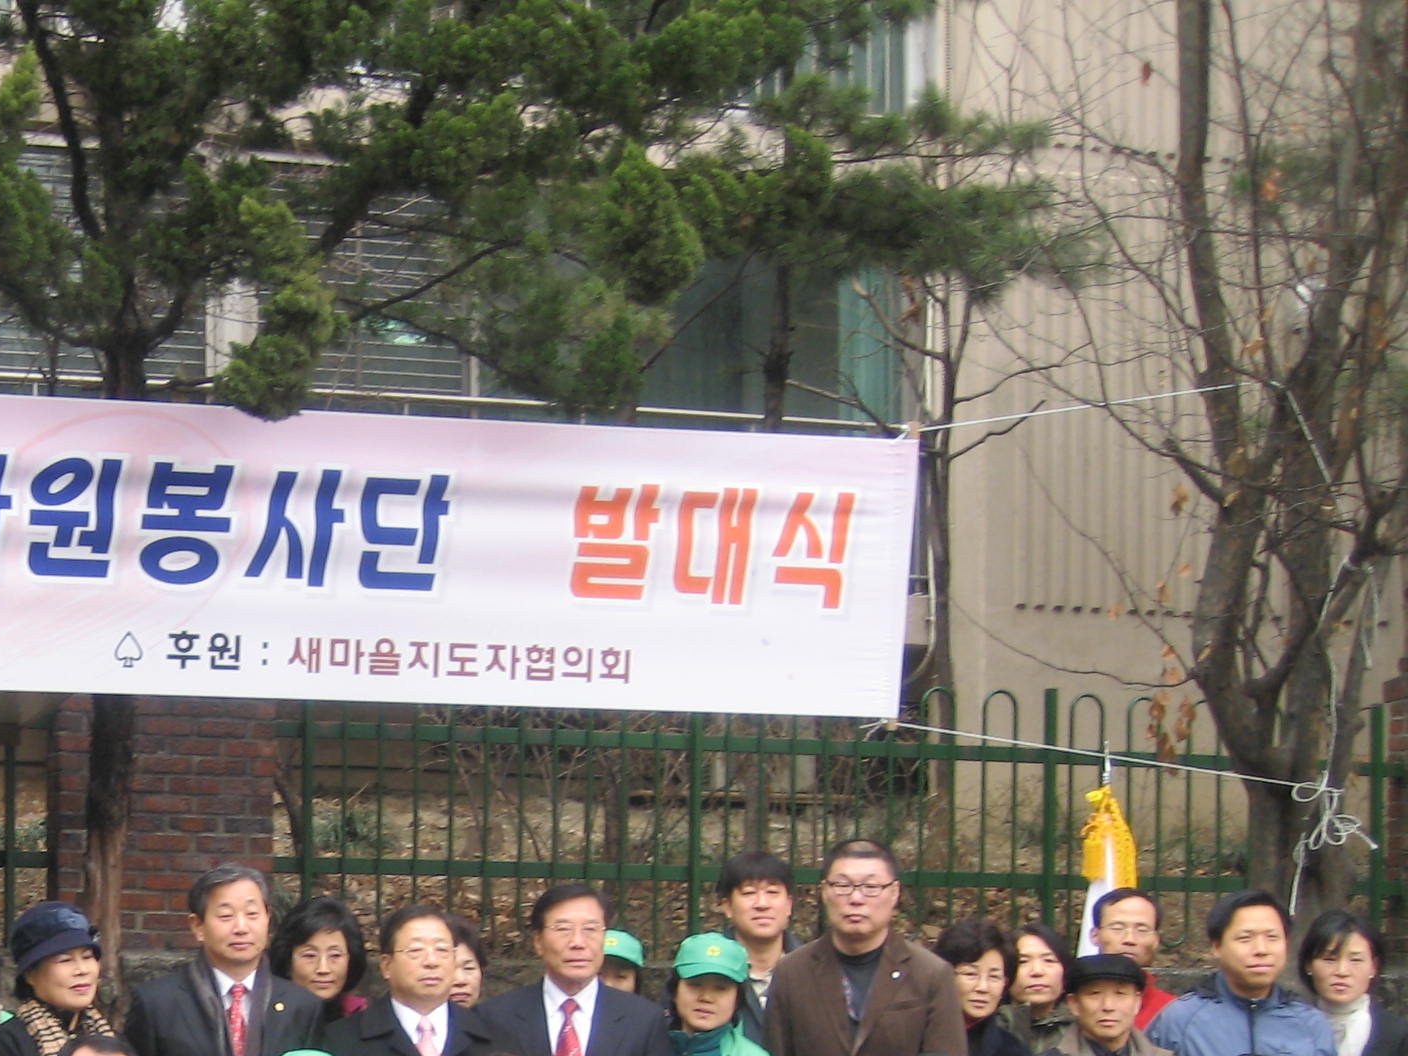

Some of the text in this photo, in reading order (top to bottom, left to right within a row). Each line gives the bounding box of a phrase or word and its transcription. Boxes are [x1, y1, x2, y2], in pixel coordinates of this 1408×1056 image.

[571, 485, 854, 609] 발대식
[165, 629, 242, 672] 후원
[287, 636, 632, 684] 새마을지도자협의회
